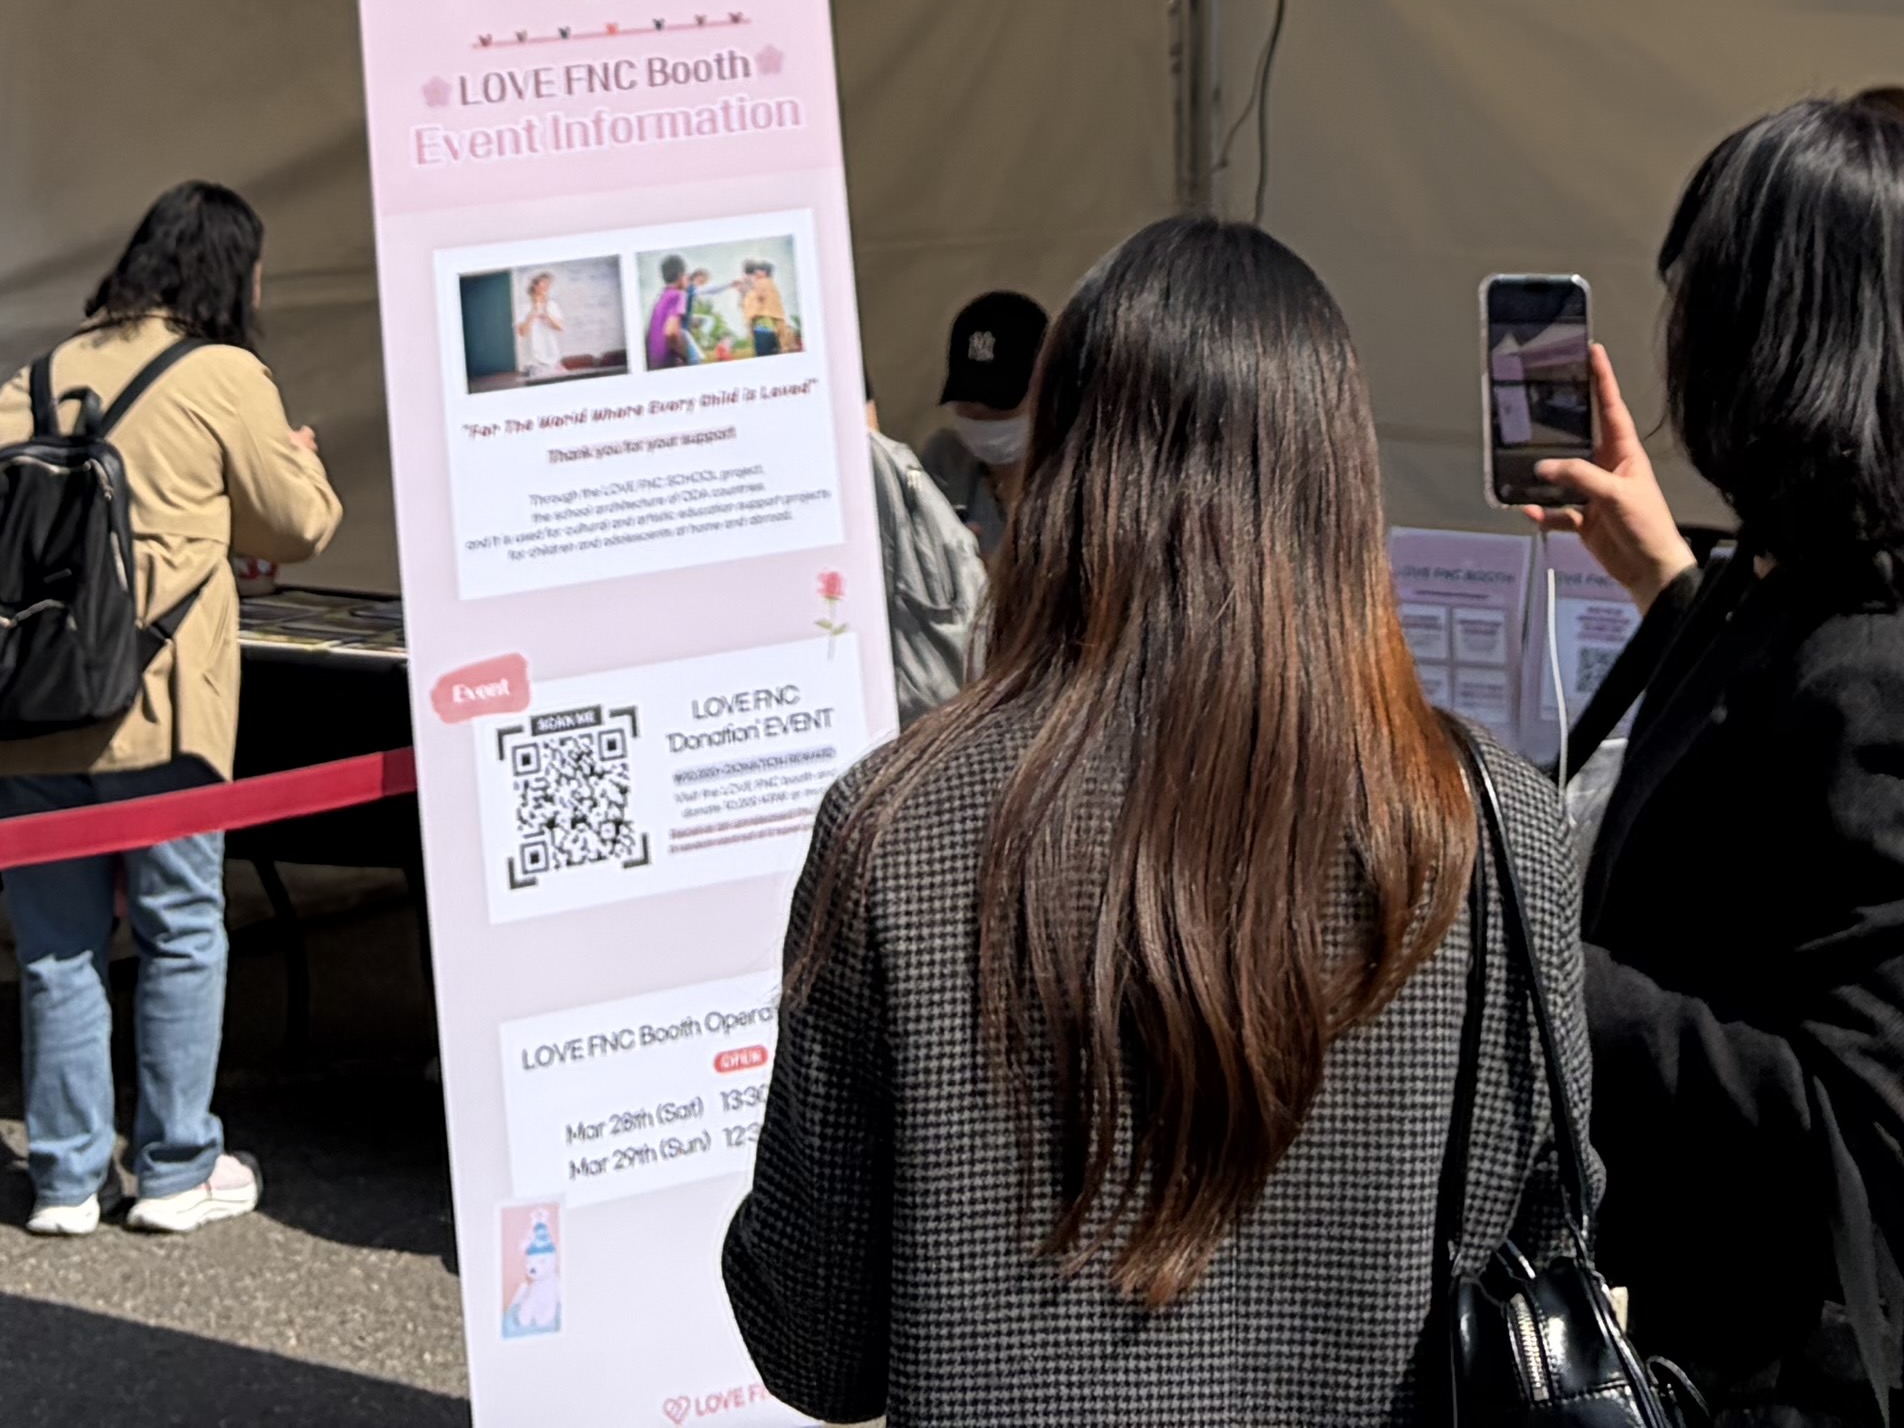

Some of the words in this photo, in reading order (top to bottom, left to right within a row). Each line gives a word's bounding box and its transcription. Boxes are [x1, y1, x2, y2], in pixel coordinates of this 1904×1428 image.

[459, 67, 557, 106] LOVE
[565, 59, 638, 95] FNC
[648, 51, 751, 88] Booth
[415, 118, 539, 165] Event
[553, 96, 800, 151] Information
[549, 444, 592, 465] Thank
[595, 442, 621, 460] you
[623, 439, 644, 454] for
[646, 435, 678, 453] your
[452, 678, 510, 703] Event
[692, 692, 751, 720] LOVE
[753, 684, 800, 711] FNC
[764, 707, 834, 737] EVENT
[522, 1038, 585, 1071] LOVE
[588, 1029, 636, 1058] FNC
[639, 1015, 702, 1046] Booth
[704, 1006, 775, 1037] Opera
[565, 1120, 604, 1146] Mar
[608, 1108, 655, 1137] 28th
[656, 1095, 705, 1126] (Sat)
[568, 1155, 608, 1181] Mar
[612, 1142, 659, 1172] 29th
[660, 1129, 712, 1161] (Sun)
[695, 1385, 745, 1416] LOVE
